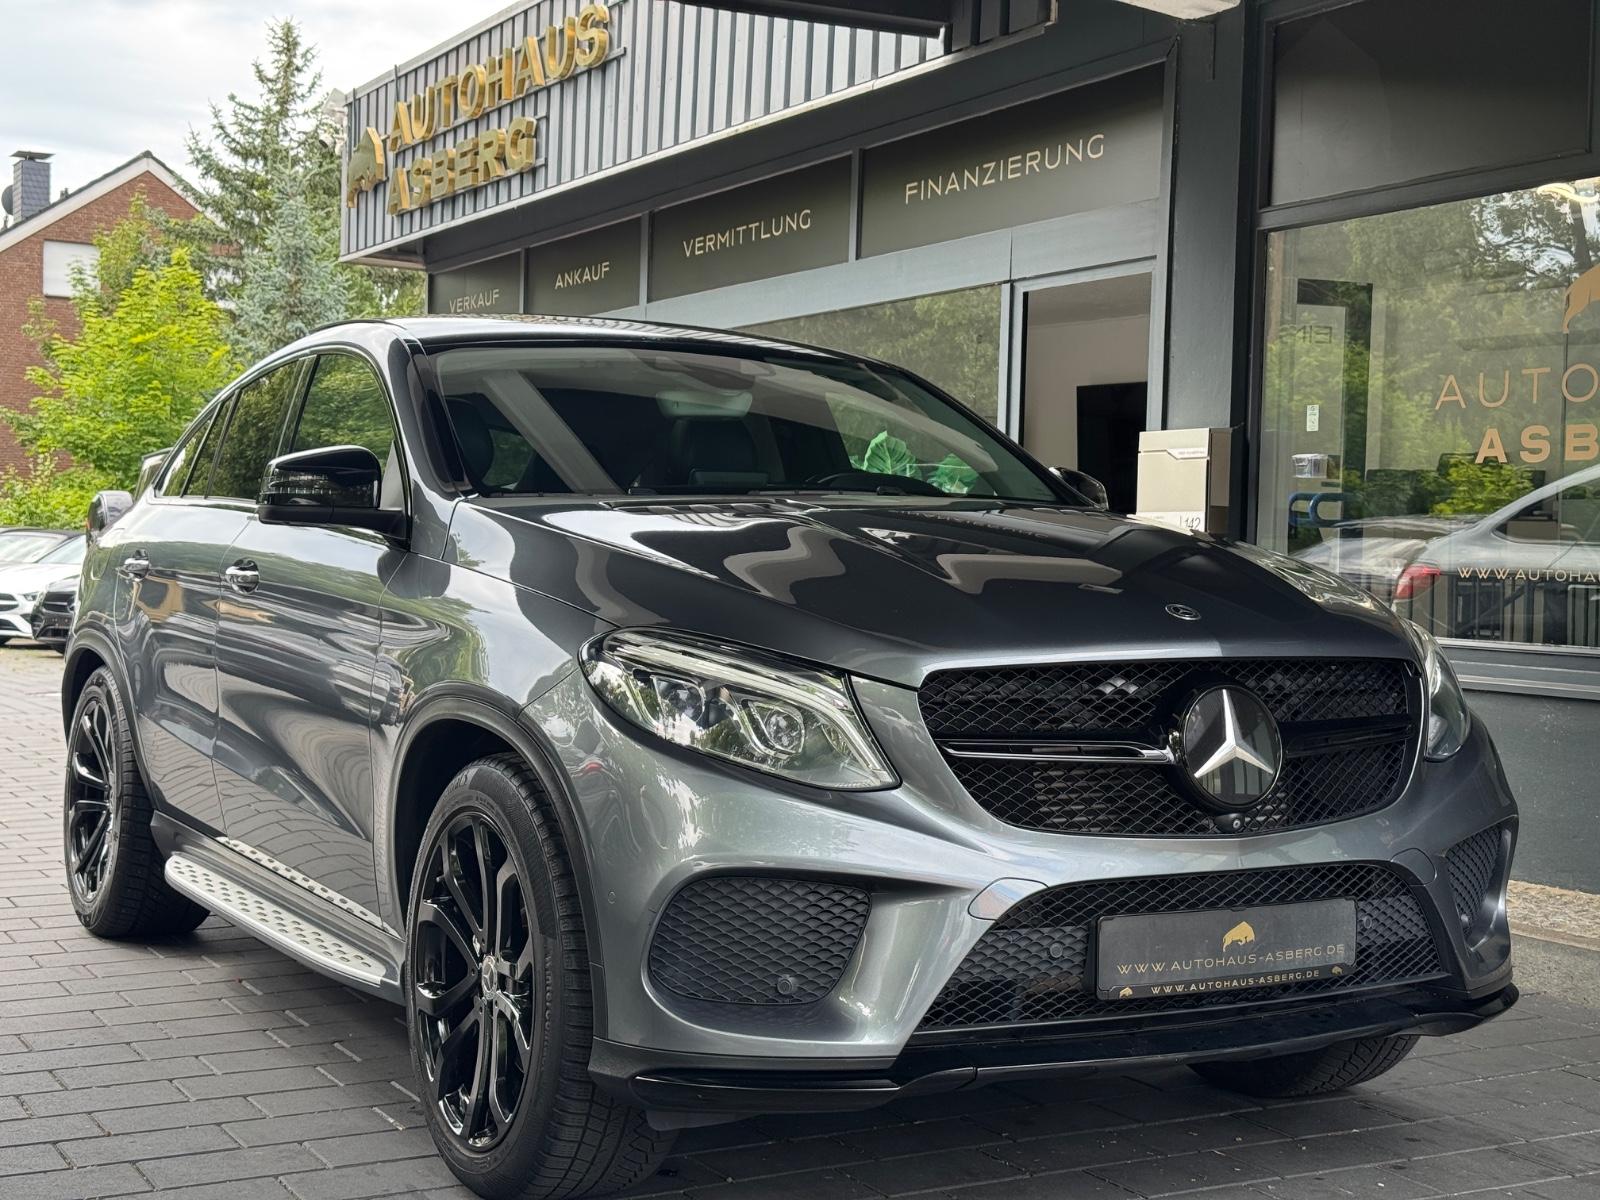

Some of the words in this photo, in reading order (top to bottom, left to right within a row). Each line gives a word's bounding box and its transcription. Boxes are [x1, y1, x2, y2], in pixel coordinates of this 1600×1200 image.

[389, 3, 610, 154] AUTOHAUS
[387, 117, 537, 216] ASBERG
[905, 134, 1104, 204] FINANZIERUNG
[682, 209, 811, 257] VERMITTLUNG
[554, 261, 610, 290] ANKAUF
[449, 289, 500, 313] VERKAUF
[1435, 363, 1599, 410] AUTO
[1475, 423, 1600, 464] ASB
[1458, 567, 1600, 582] WWW.AUTOHA
[1117, 944, 1345, 975] WWW.AUTOHAUS-ASBERG.DE
[1151, 970, 1319, 995] WWW.AUTOHAUS-ASBERG.DE
